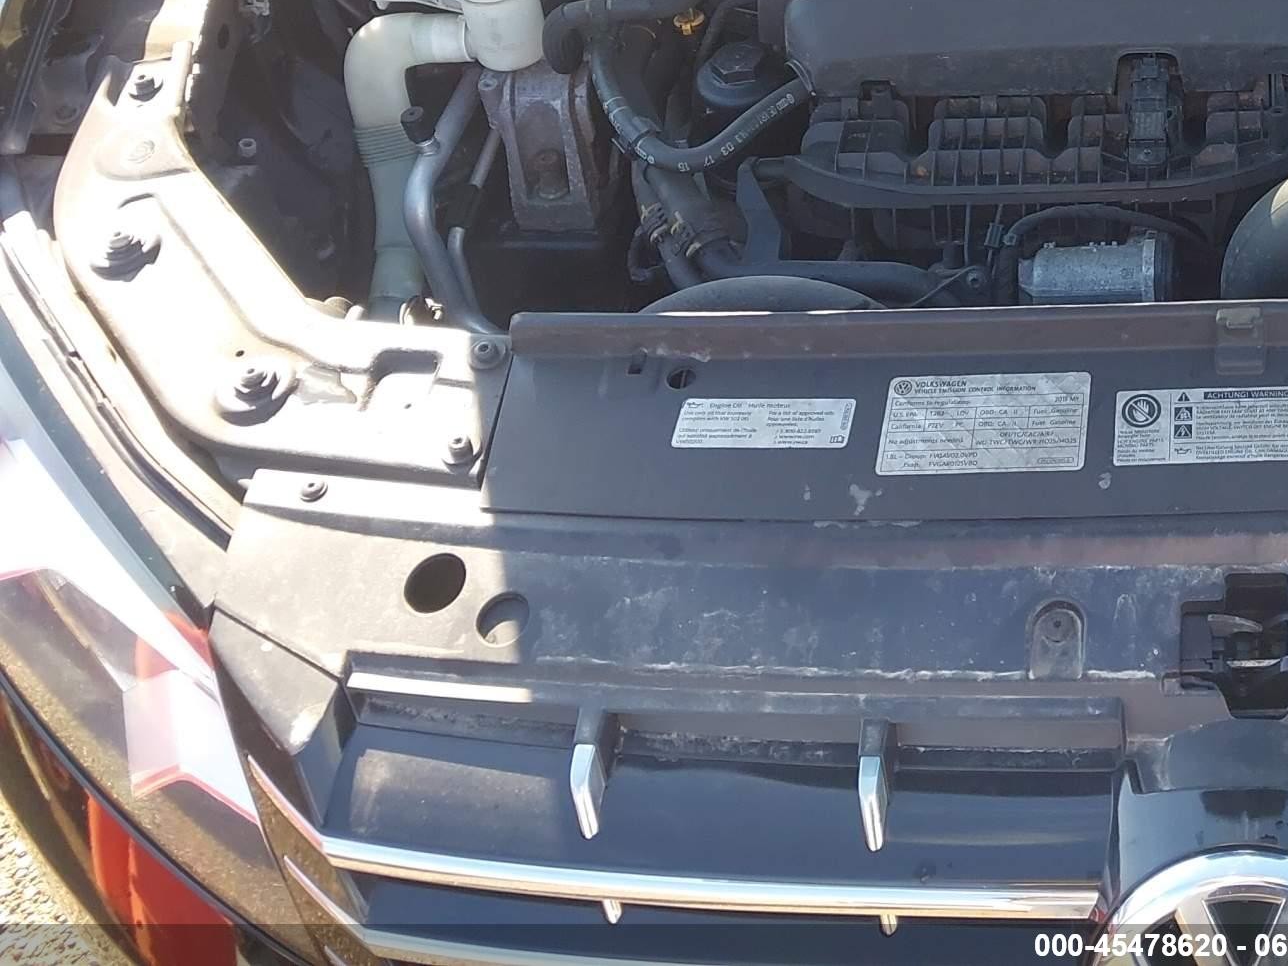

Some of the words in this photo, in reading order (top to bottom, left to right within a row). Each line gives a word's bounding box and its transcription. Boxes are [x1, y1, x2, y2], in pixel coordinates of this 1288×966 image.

[915, 380, 967, 388] VOLKSWAGEN
[996, 385, 1036, 393] INFORMATION
[1207, 391, 1249, 399] ACHTUNG!
